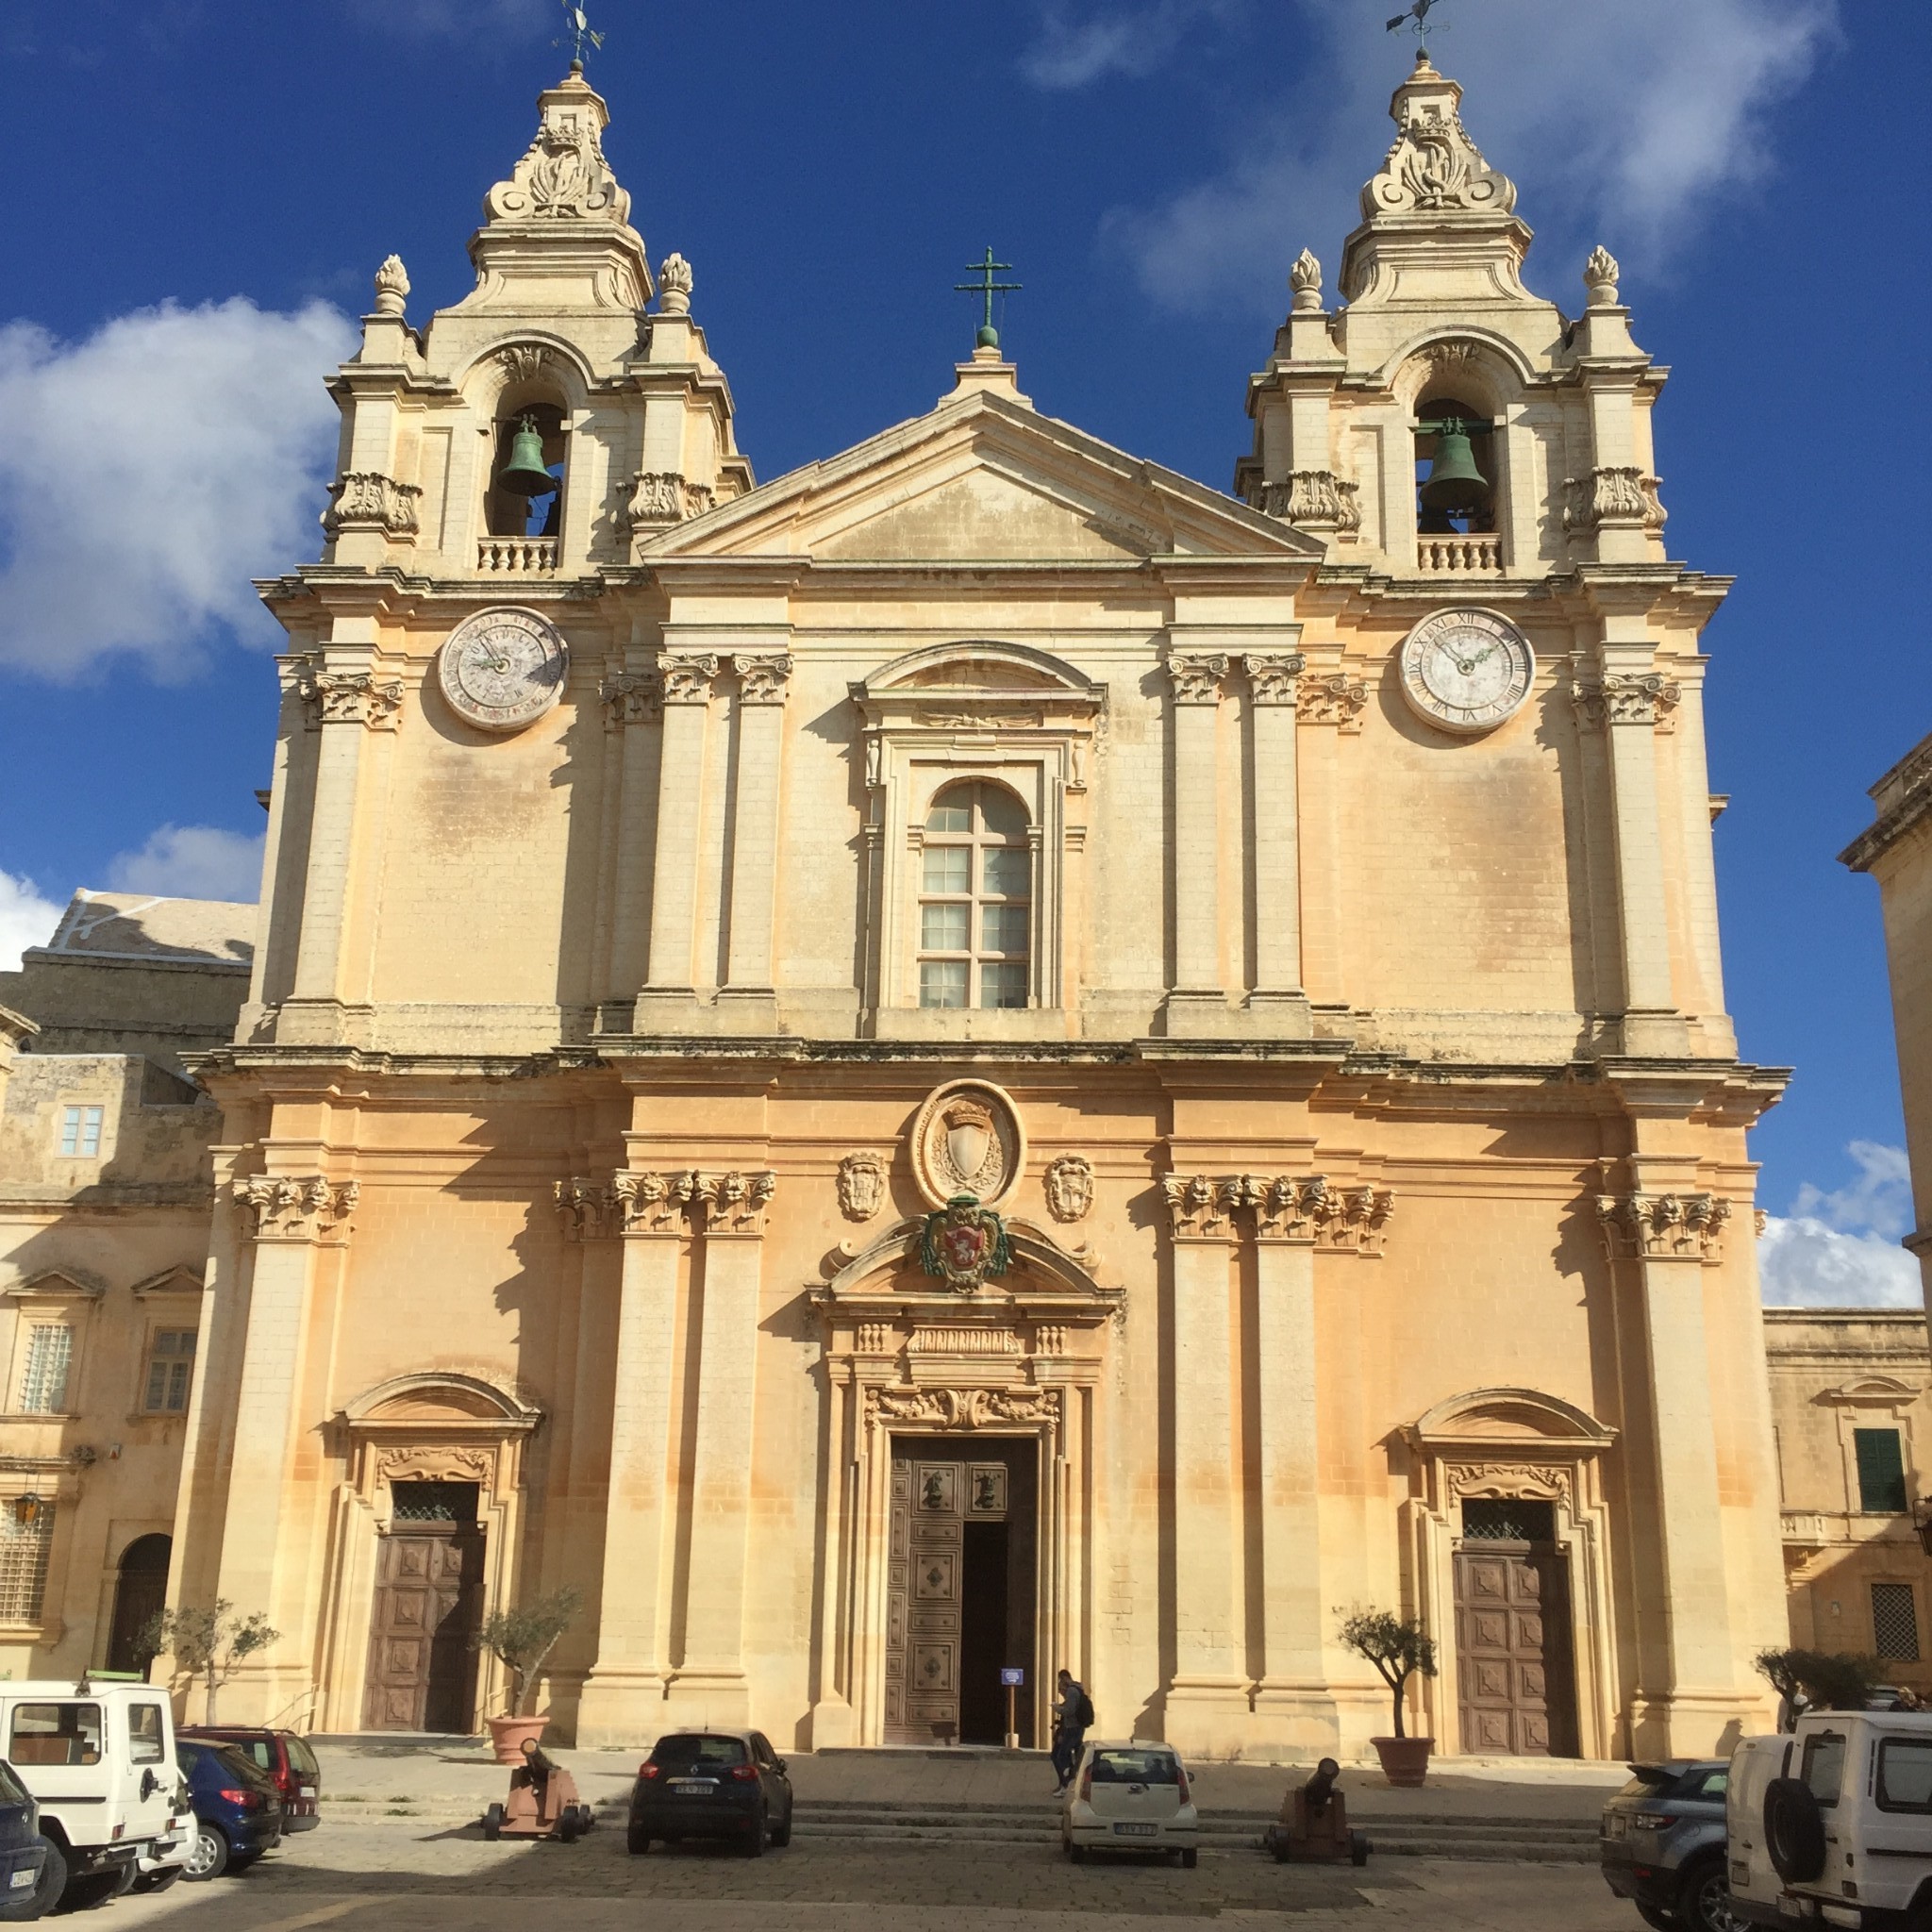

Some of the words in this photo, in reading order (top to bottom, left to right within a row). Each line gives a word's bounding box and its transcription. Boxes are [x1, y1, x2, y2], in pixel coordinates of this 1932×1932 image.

[1432, 618, 1447, 632] XI
[1457, 613, 1474, 625] XII
[1414, 637, 1427, 649] X
[1408, 661, 1421, 673] IX
[1514, 661, 1526, 672] III
[1507, 684, 1523, 699] IIII
[1463, 709, 1476, 721] VI
